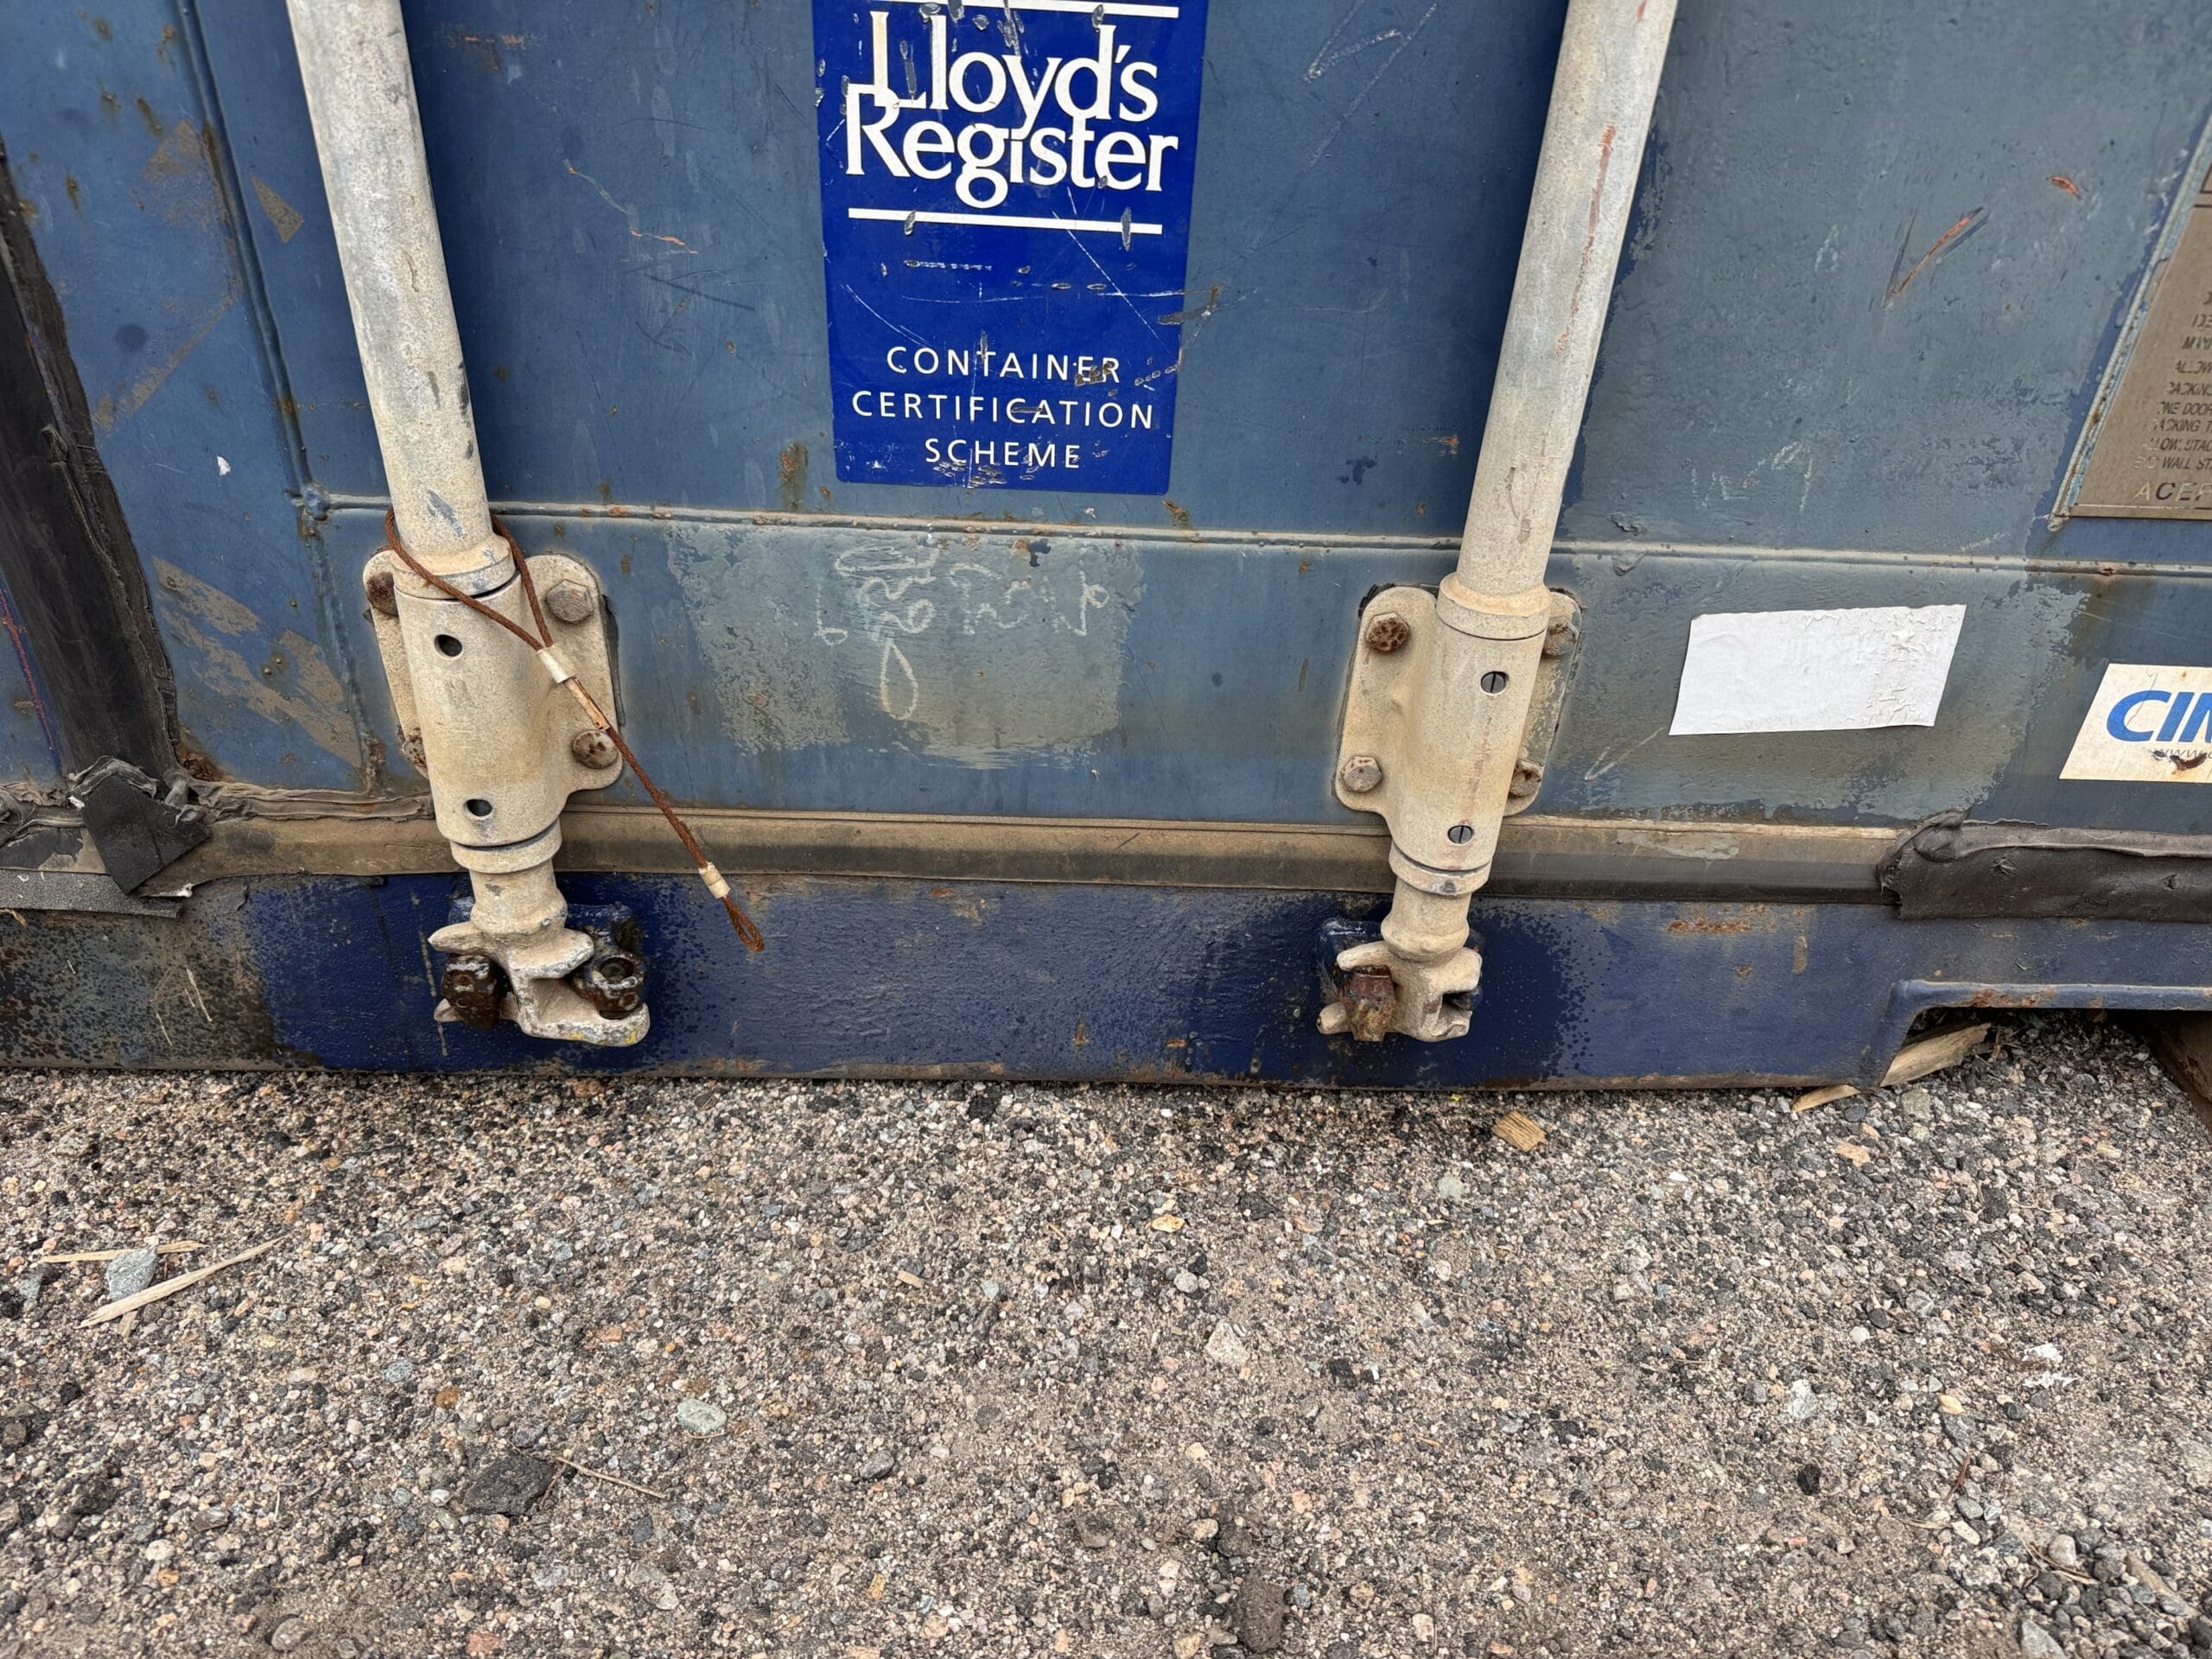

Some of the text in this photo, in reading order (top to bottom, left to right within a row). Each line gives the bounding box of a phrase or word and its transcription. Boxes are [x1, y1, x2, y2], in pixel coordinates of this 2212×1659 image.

[870, 11, 1159, 140] Lloyd's
[845, 83, 1179, 209] Register
[887, 346, 1121, 385] CONTAINER
[852, 390, 1154, 429] CERTIFICATION
[925, 437, 1081, 469] SCHEME
[2162, 456, 2190, 470] WALL
